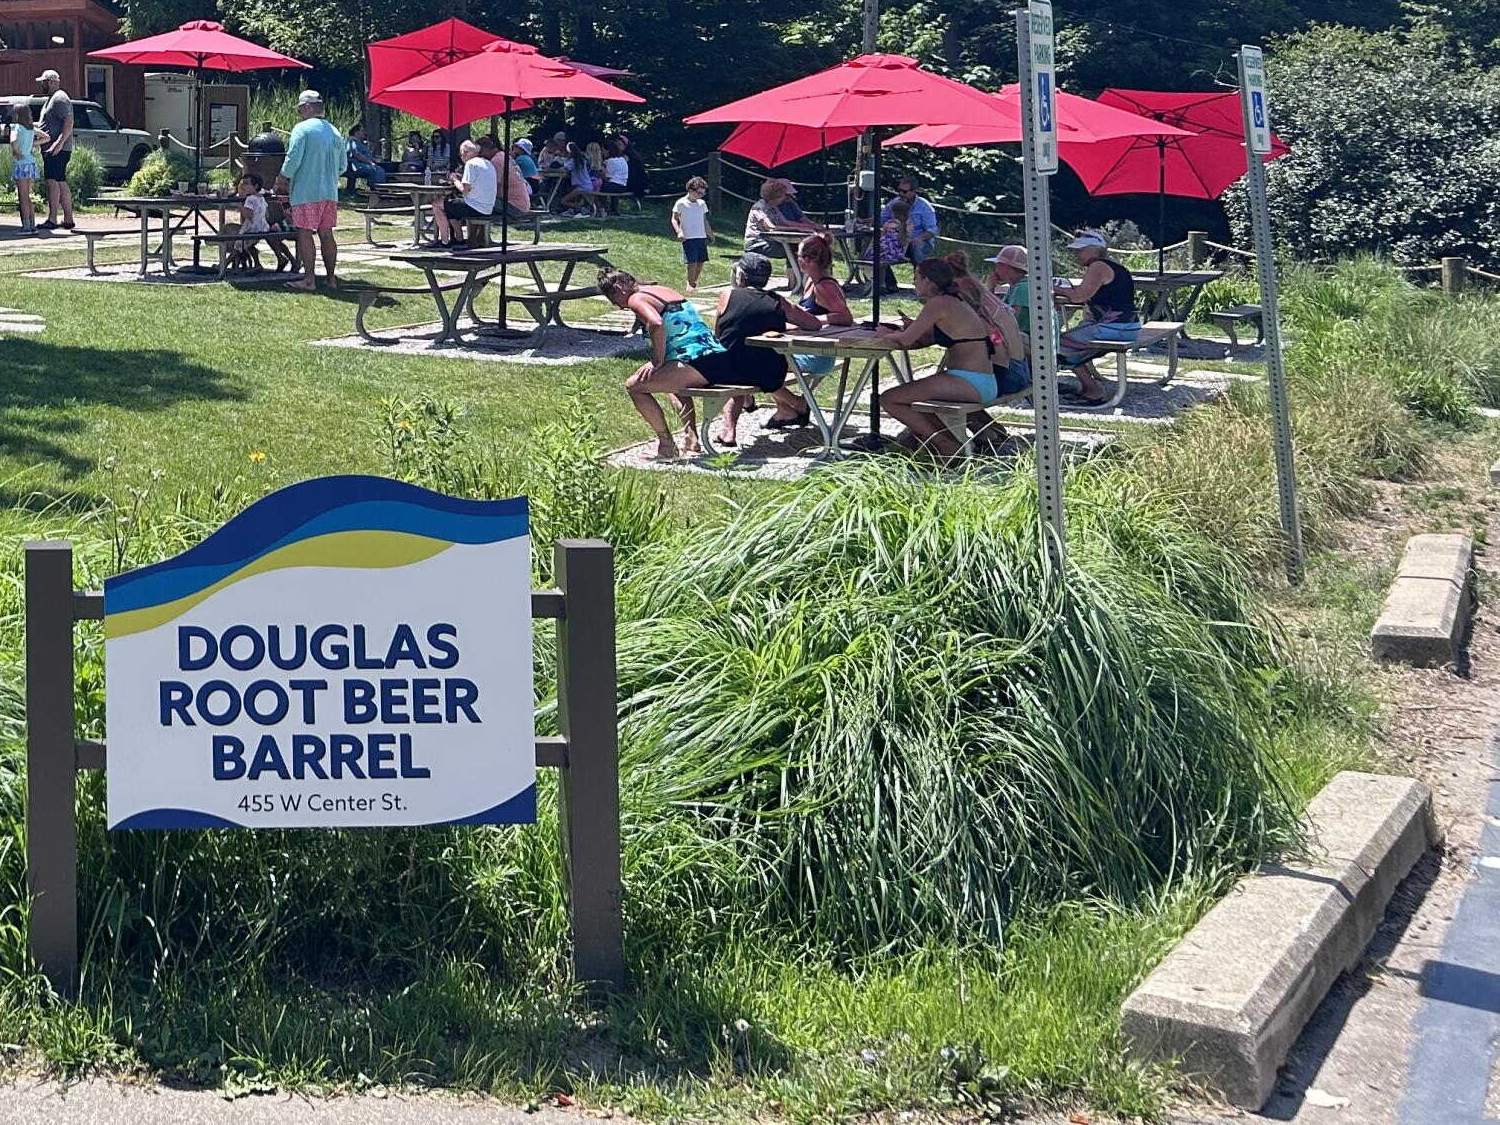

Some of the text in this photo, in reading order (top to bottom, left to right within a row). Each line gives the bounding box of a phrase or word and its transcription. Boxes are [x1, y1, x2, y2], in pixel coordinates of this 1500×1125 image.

[178, 623, 460, 671] DOUGLAS
[159, 678, 482, 726] ROOT BEER
[212, 733, 431, 781] BARREL
[238, 792, 408, 813] 455 W Center St.
